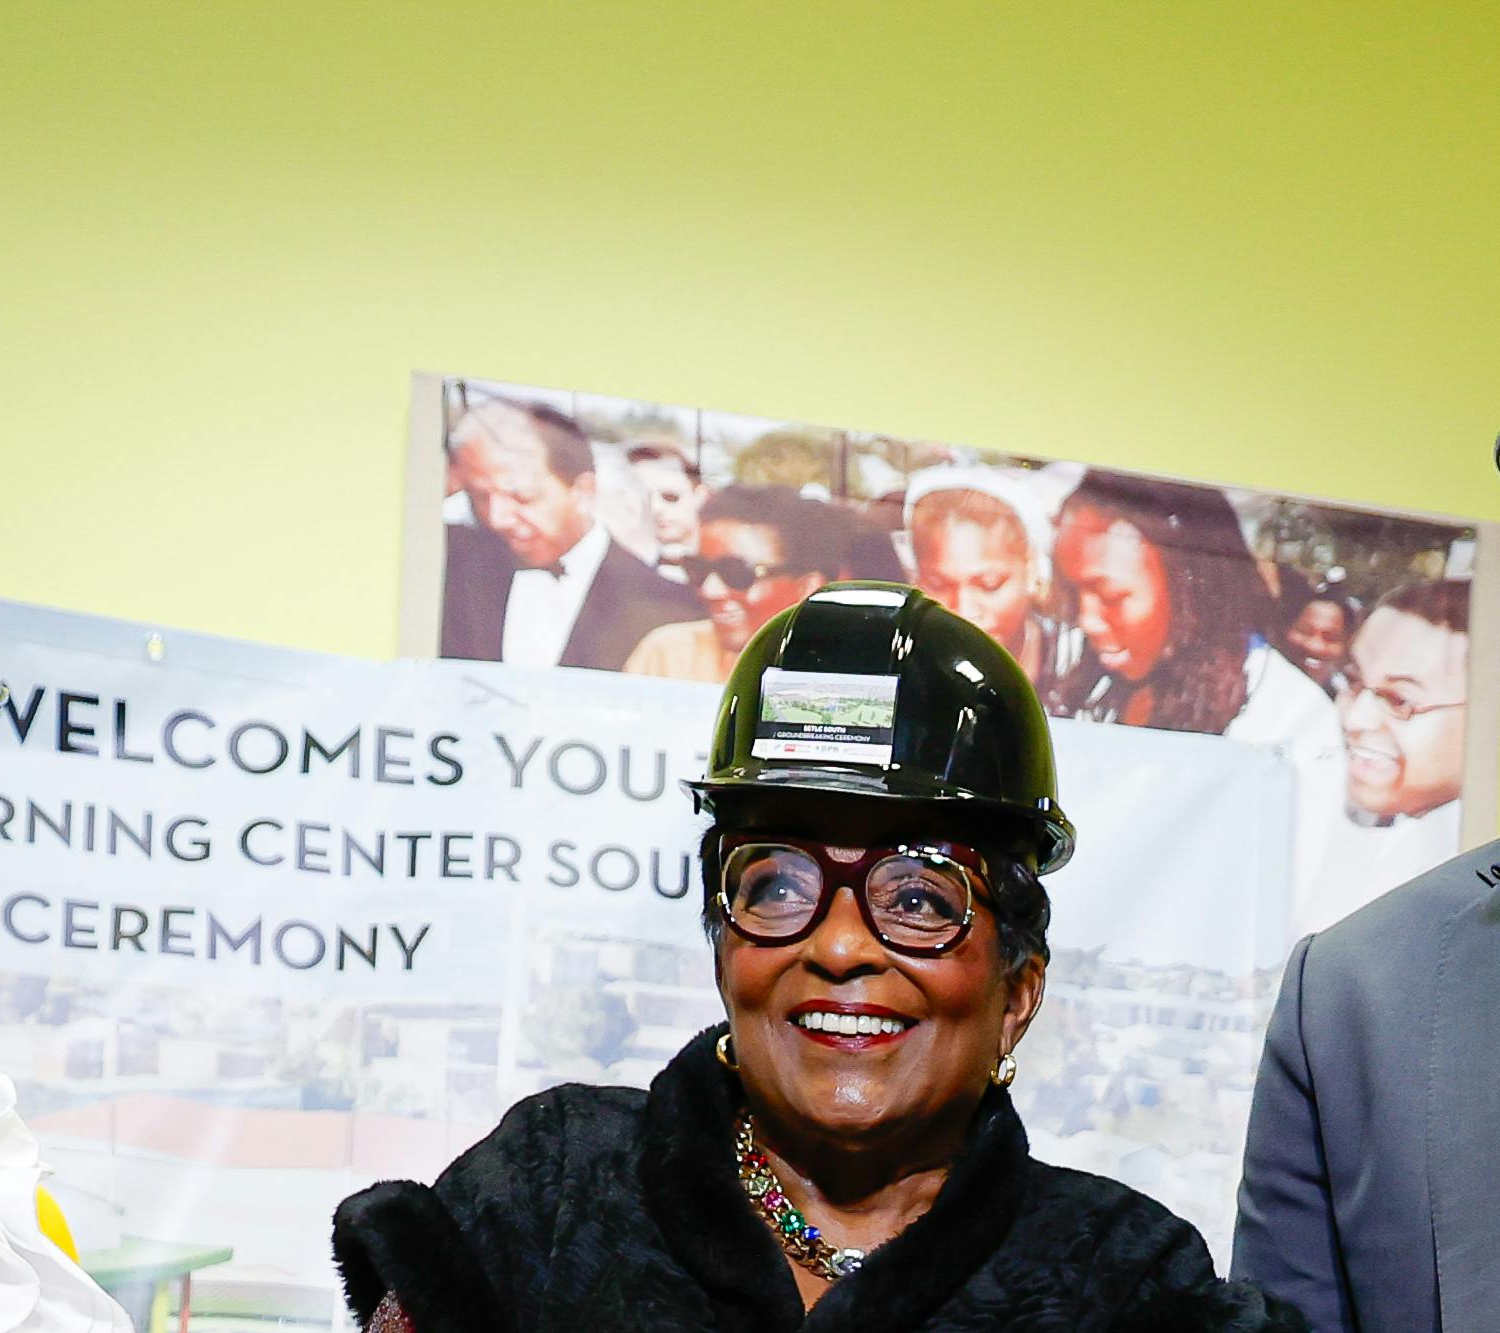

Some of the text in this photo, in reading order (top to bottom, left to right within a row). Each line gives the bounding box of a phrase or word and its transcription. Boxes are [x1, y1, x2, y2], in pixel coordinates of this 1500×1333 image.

[491, 732, 667, 801] YOU
[238, 817, 522, 883] CENTER
[547, 838, 690, 899] SOU
[2, 891, 432, 971] CEREMONY
